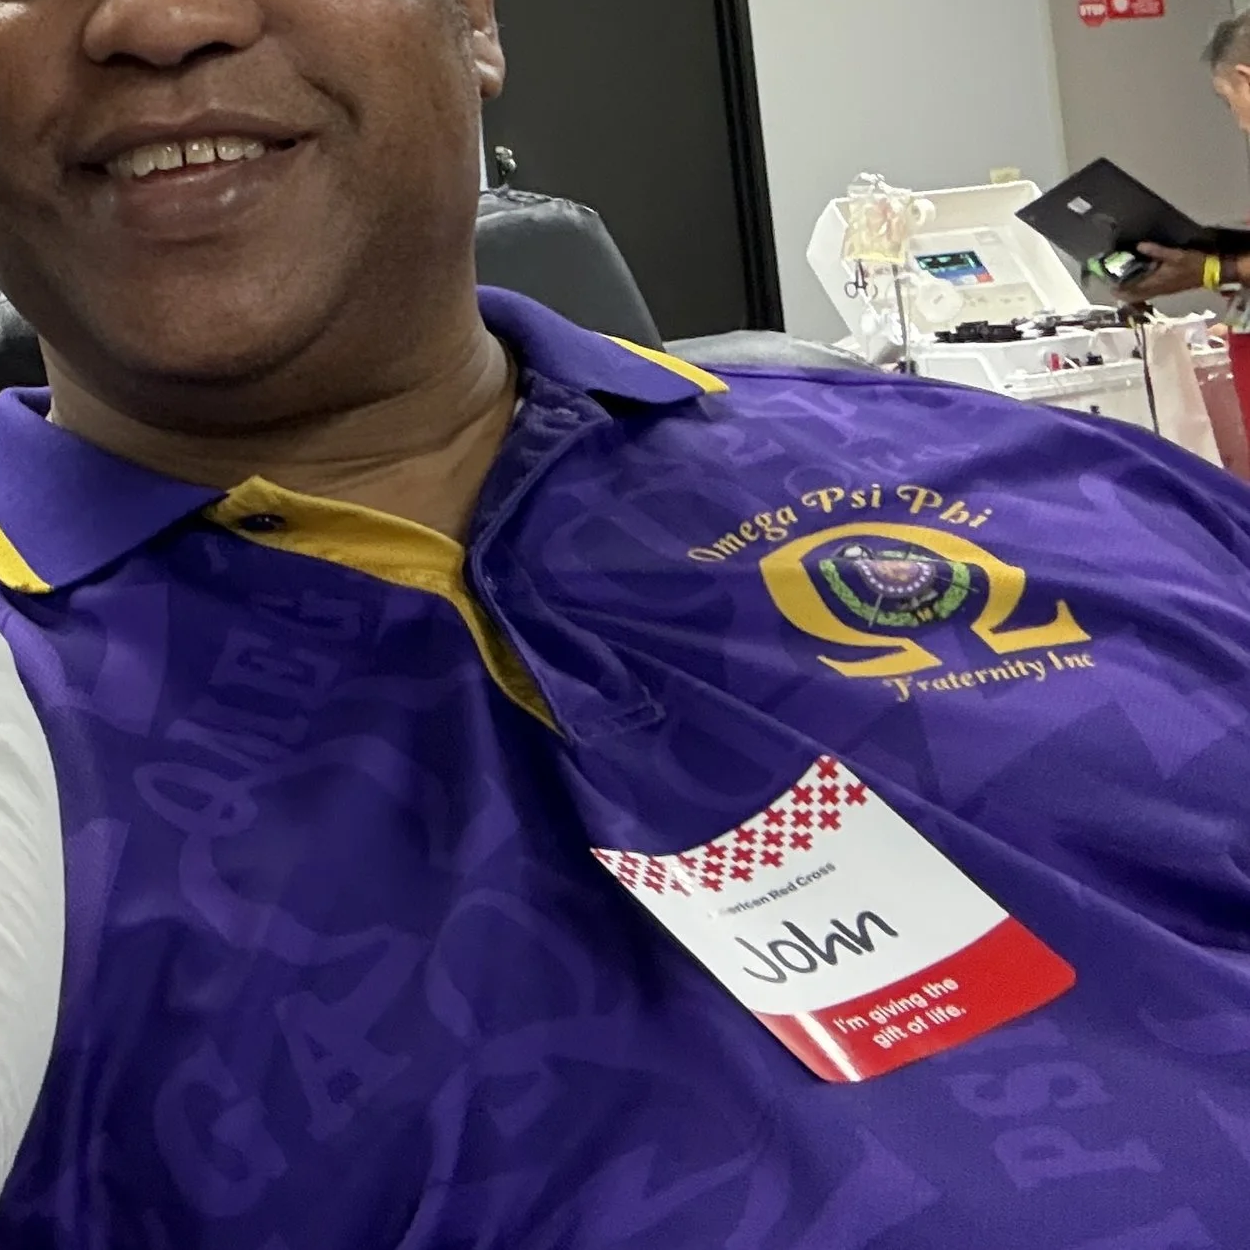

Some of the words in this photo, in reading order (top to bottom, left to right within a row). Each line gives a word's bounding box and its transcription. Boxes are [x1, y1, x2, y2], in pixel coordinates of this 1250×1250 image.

[687, 506, 798, 562] Omega
[801, 483, 881, 513] Psi
[896, 484, 993, 528] Phi
[882, 660, 1046, 702] Fraternity
[1047, 651, 1095, 671] Inc
[767, 881, 798, 901] Red
[795, 862, 837, 887] Cross
[734, 911, 899, 984] John
[833, 1015, 869, 1034] I'm
[868, 992, 928, 1025] giving
[921, 978, 959, 998] the
[872, 1025, 908, 1049] gift
[907, 1015, 929, 1034] of
[925, 1004, 967, 1024] life.
